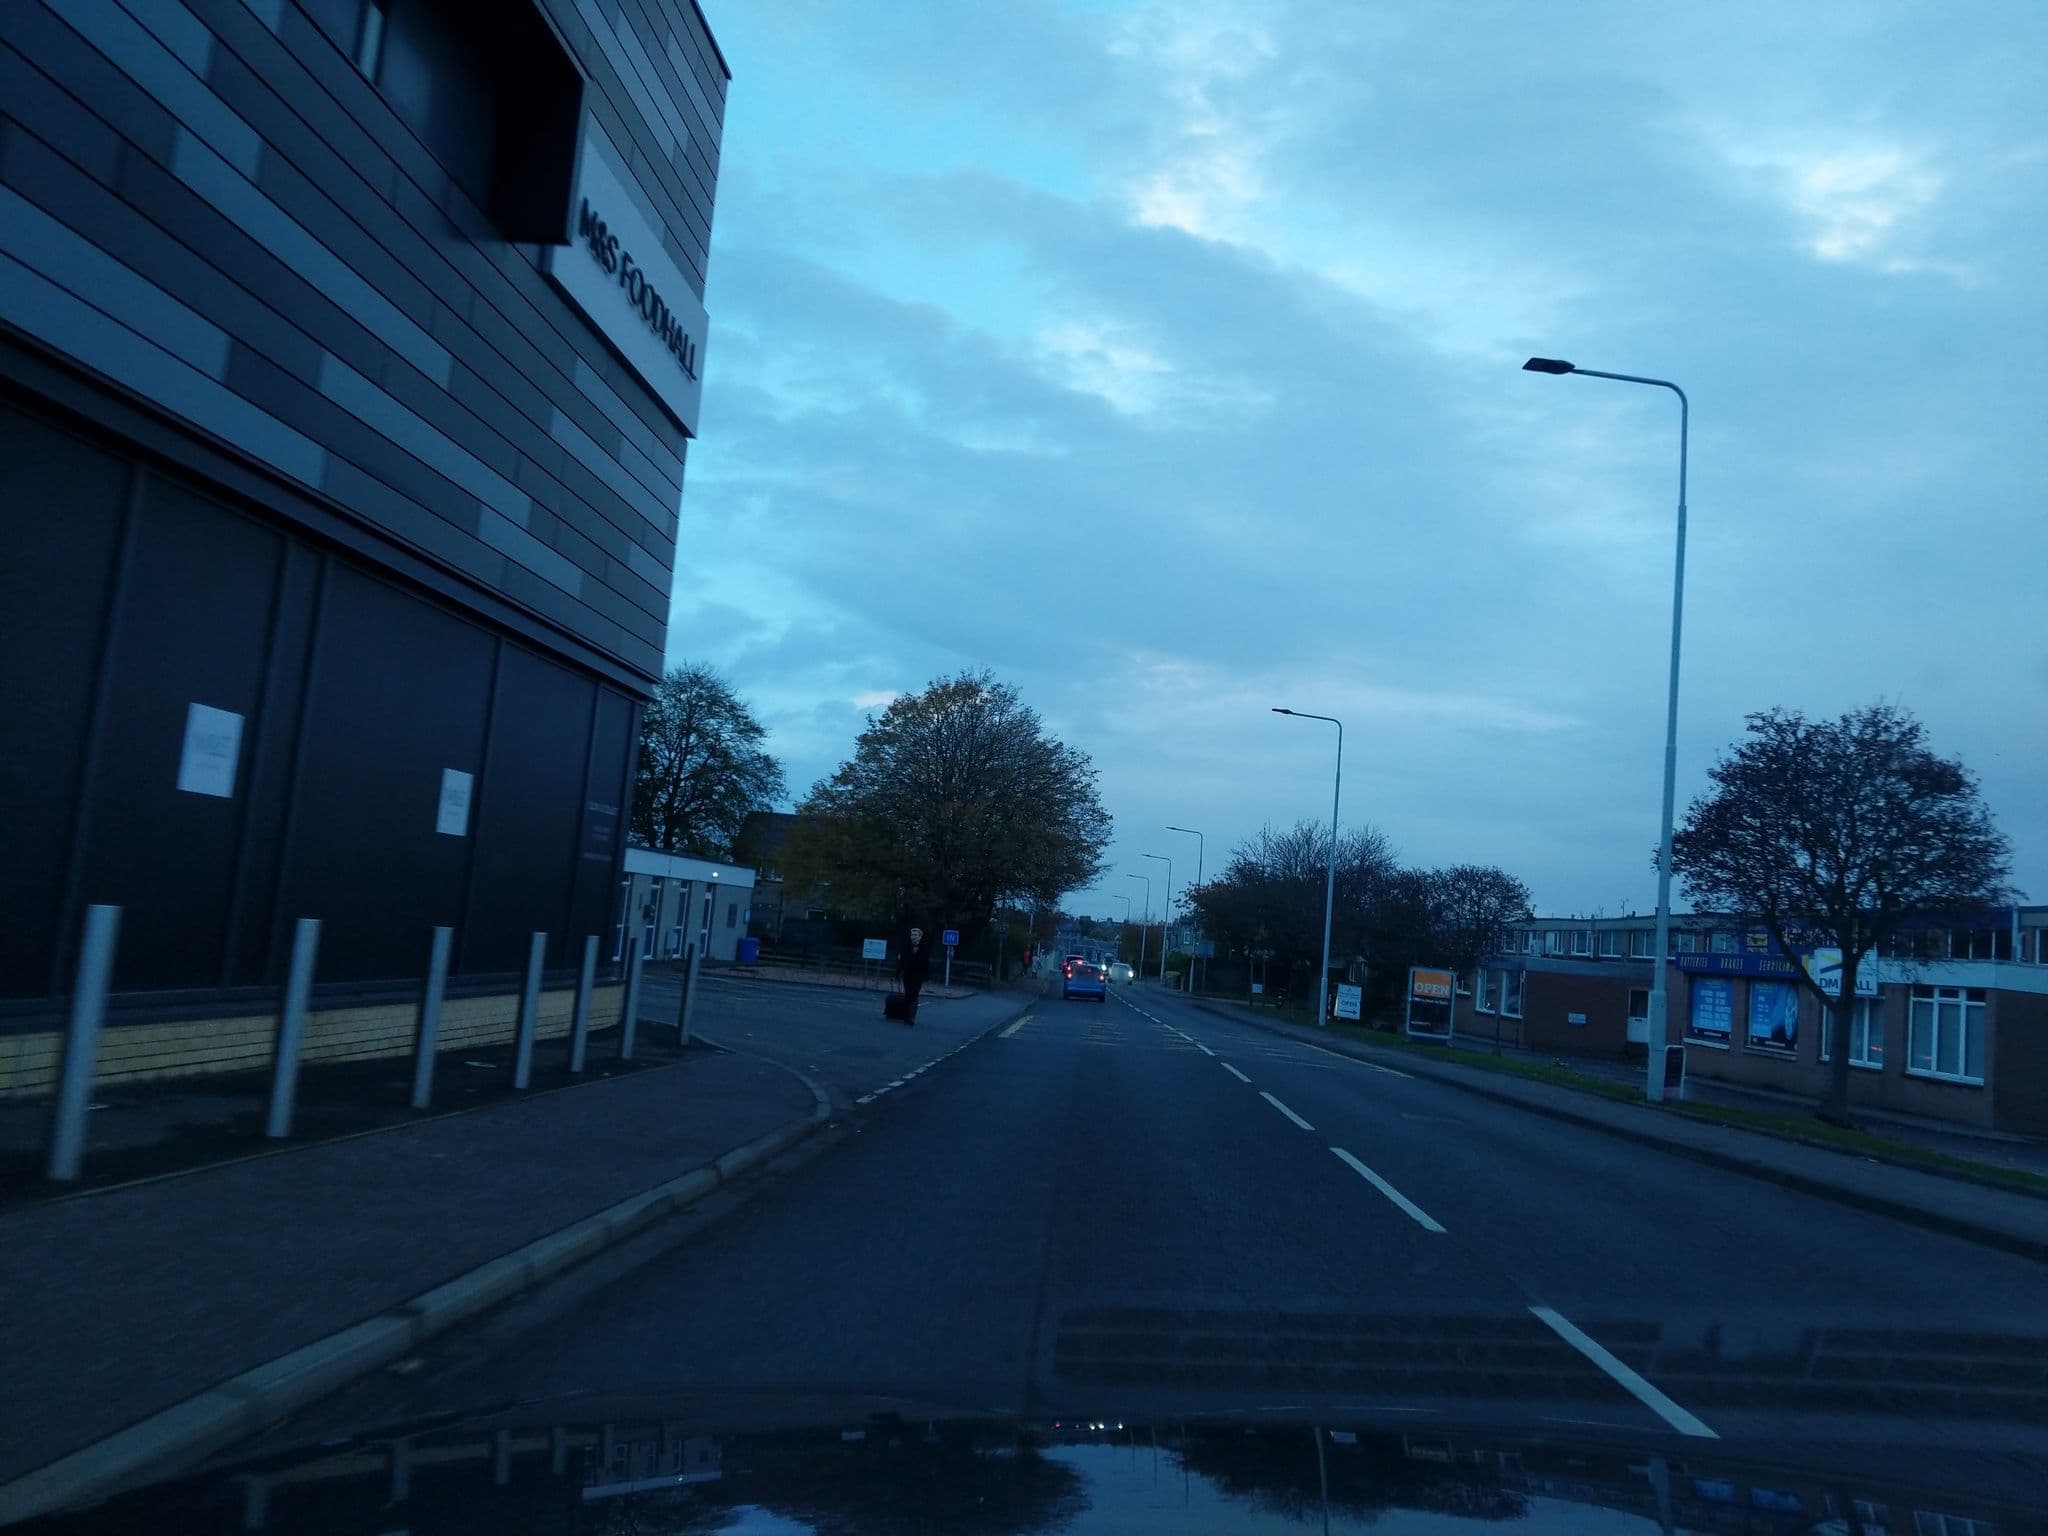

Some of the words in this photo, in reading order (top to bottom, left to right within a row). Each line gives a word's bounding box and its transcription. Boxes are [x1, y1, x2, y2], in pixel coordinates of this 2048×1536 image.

[580, 197, 619, 274] M&S
[620, 251, 697, 381] FOODHALL
[1413, 982, 1450, 996] OPEN
[1819, 977, 1839, 989] DM
